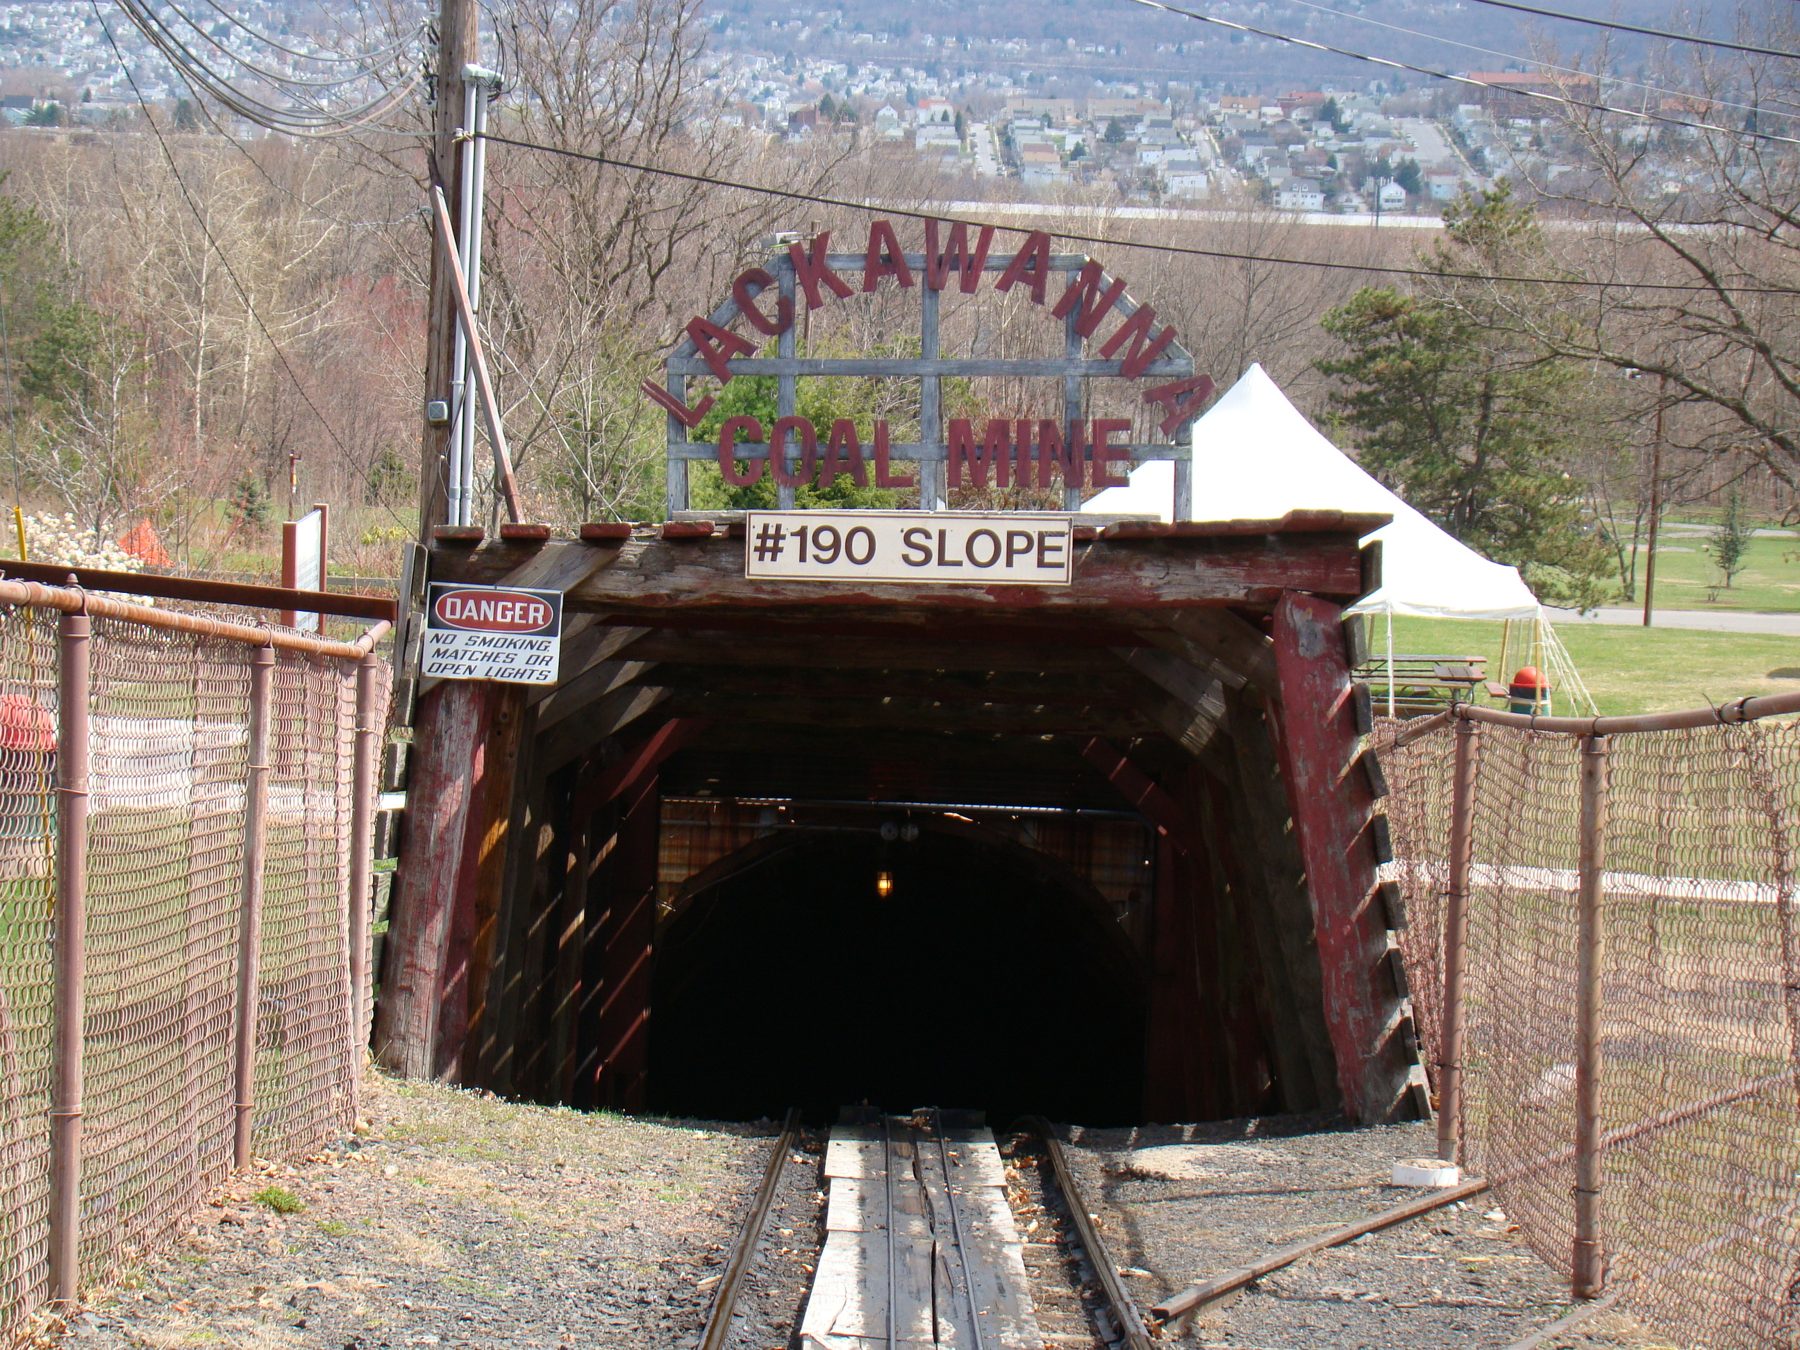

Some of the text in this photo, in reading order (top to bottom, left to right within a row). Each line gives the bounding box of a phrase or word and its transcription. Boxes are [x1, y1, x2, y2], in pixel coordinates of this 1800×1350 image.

[641, 219, 1216, 436] LACKAWANNA
[718, 416, 1131, 488] COAL MINE
[753, 523, 1066, 570] #190 SLOPE
[445, 597, 545, 625] DANGER
[429, 633, 457, 645] NO
[427, 662, 552, 681] OPEN LIGHTS
[431, 648, 554, 667] MATCHES OR
